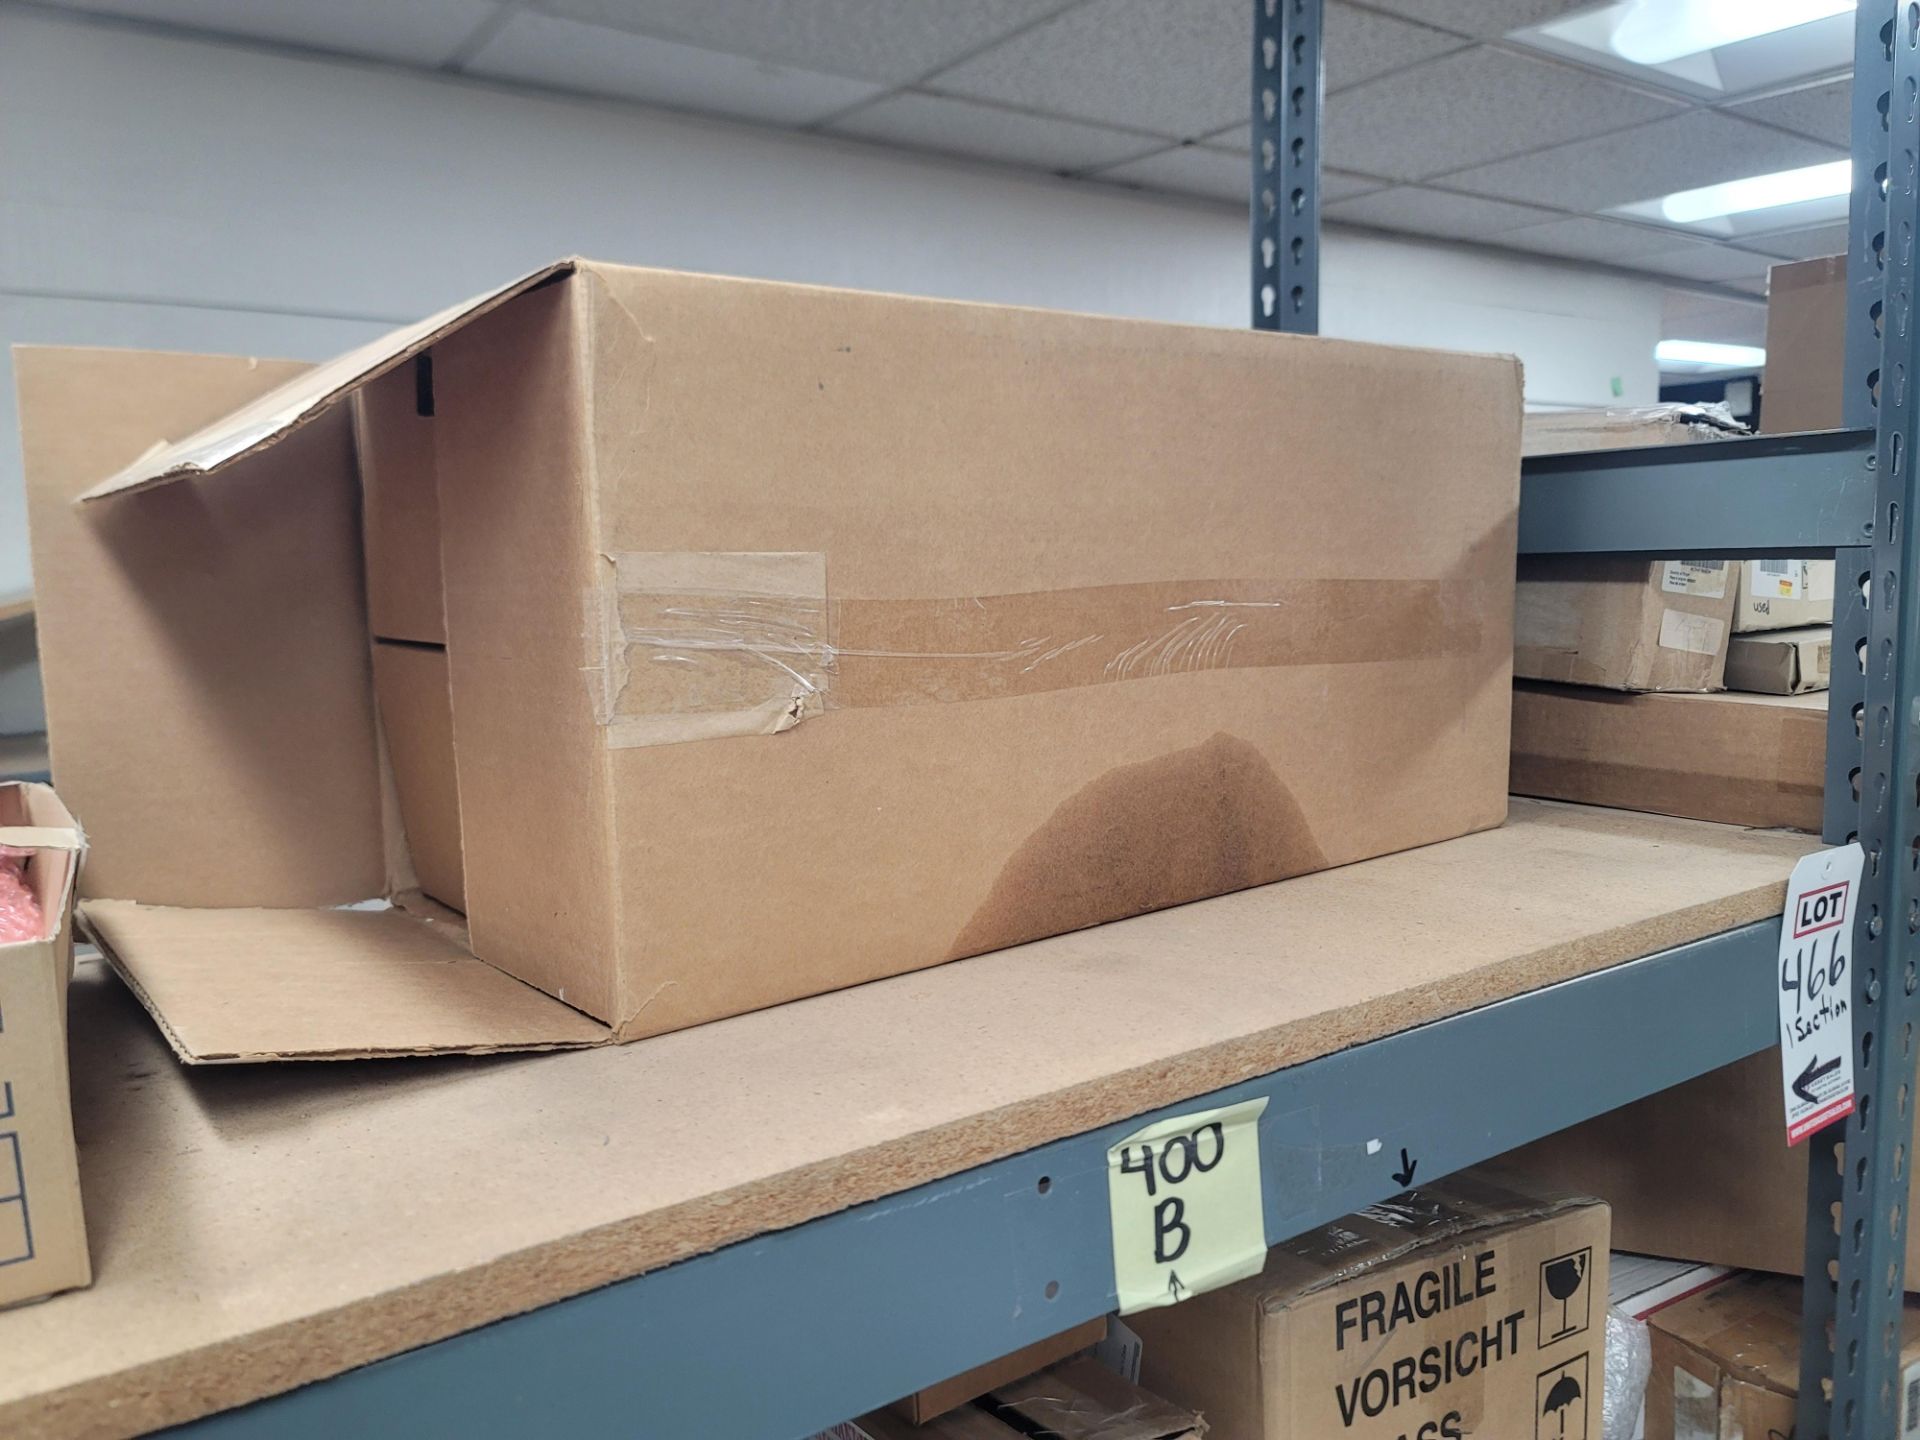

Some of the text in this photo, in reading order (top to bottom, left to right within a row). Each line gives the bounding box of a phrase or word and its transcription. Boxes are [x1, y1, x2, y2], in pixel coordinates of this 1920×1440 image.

[1800, 891, 1843, 928] LOT
[1781, 930, 1846, 1015] 466
[1795, 994, 1848, 1042] Section
[1120, 1122, 1225, 1196] 400
[1154, 1196, 1191, 1264] B
[1335, 1250, 1497, 1351] FRAGILE
[1335, 1309, 1526, 1428] VORSICHT
